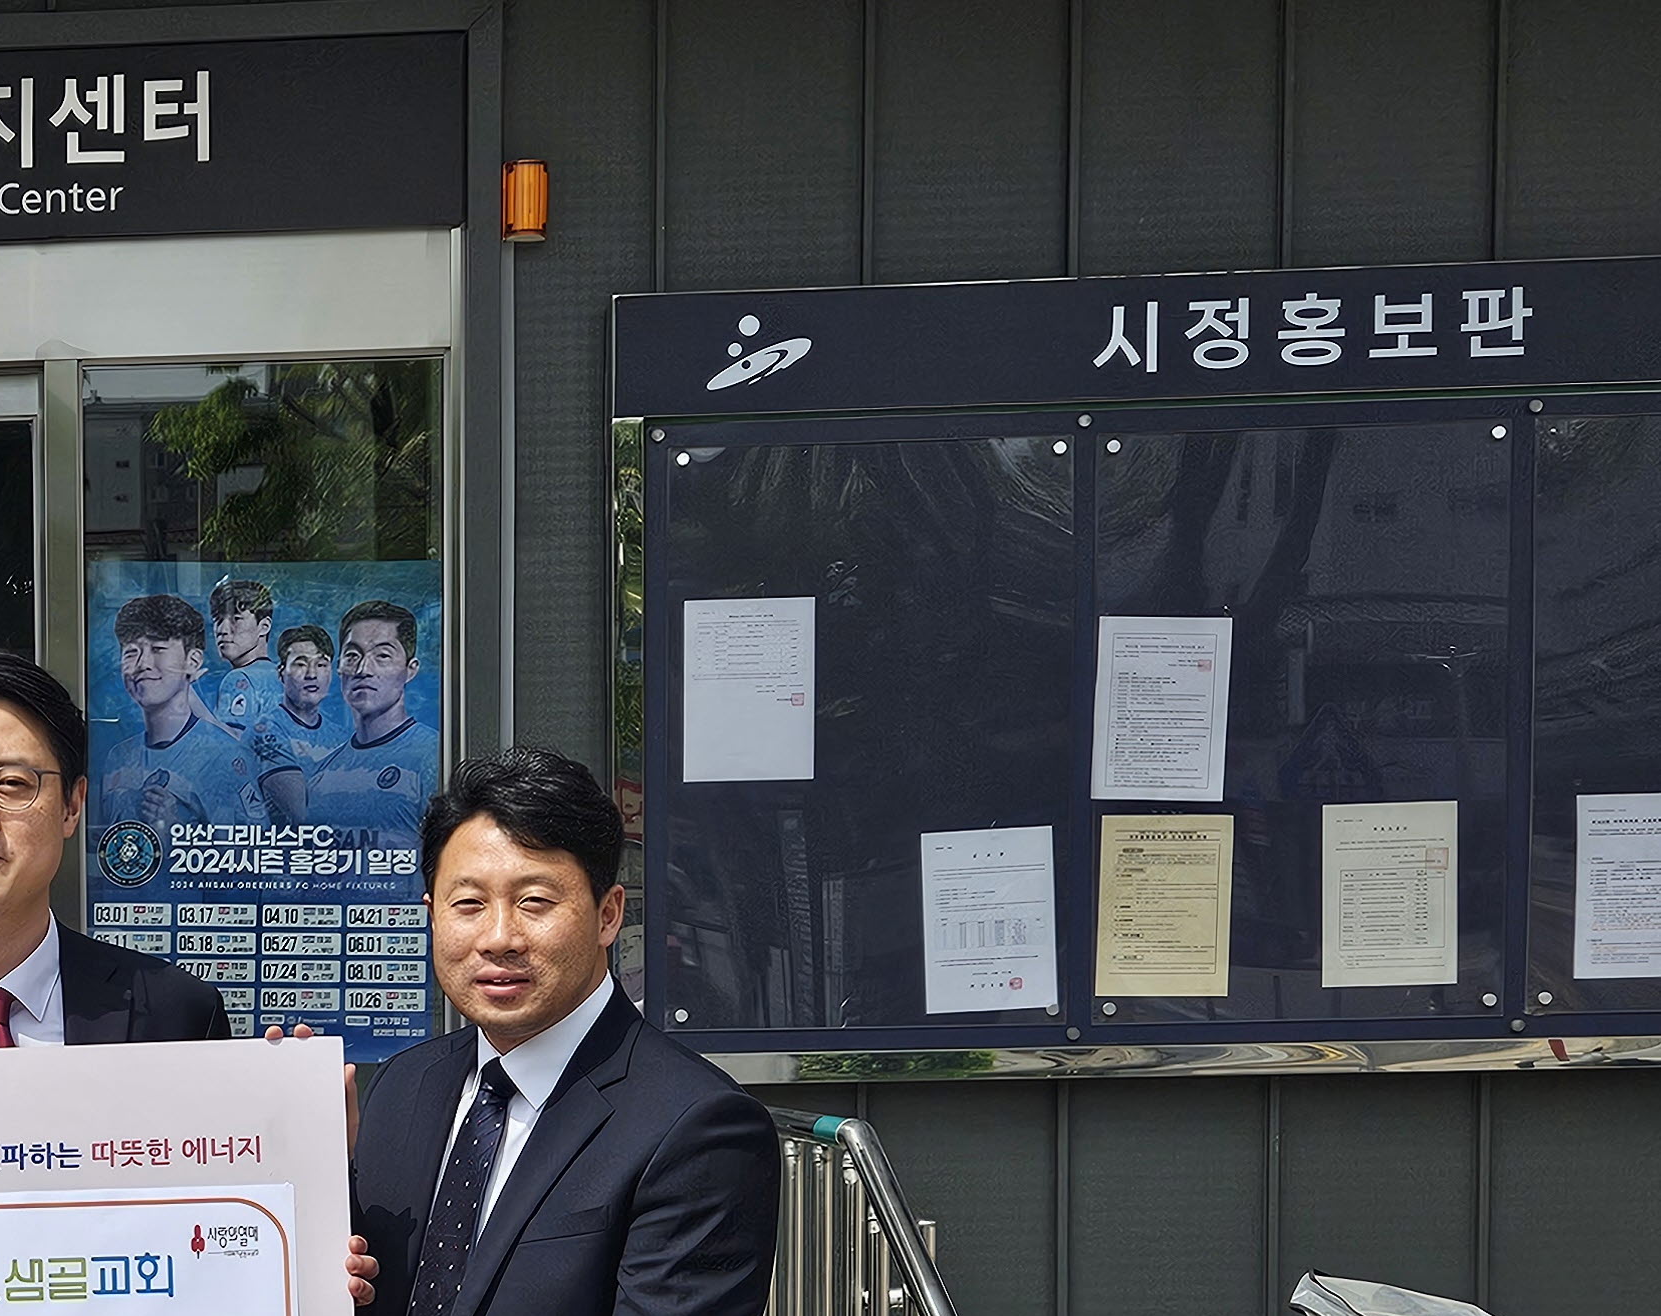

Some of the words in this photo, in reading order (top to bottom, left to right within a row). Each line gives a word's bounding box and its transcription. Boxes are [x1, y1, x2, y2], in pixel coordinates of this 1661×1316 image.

[1092, 285, 1534, 373] 시정홍보판
[169, 823, 335, 847] 안산그리너스FC
[169, 848, 285, 875] 2024시즌
[288, 848, 362, 875] 홈경기
[367, 849, 419, 876] 일정
[95, 906, 128, 923] 03.01
[178, 906, 214, 924] 03.17
[264, 907, 299, 925] 04.10
[178, 935, 213, 951] 05.18
[348, 936, 382, 953] 06.01
[91, 1137, 173, 1168] 따뜻한
[181, 1135, 262, 1165] 에너지
[207, 1225, 259, 1249] 사랑의열매
[4, 1252, 175, 1302] 샘골교회
